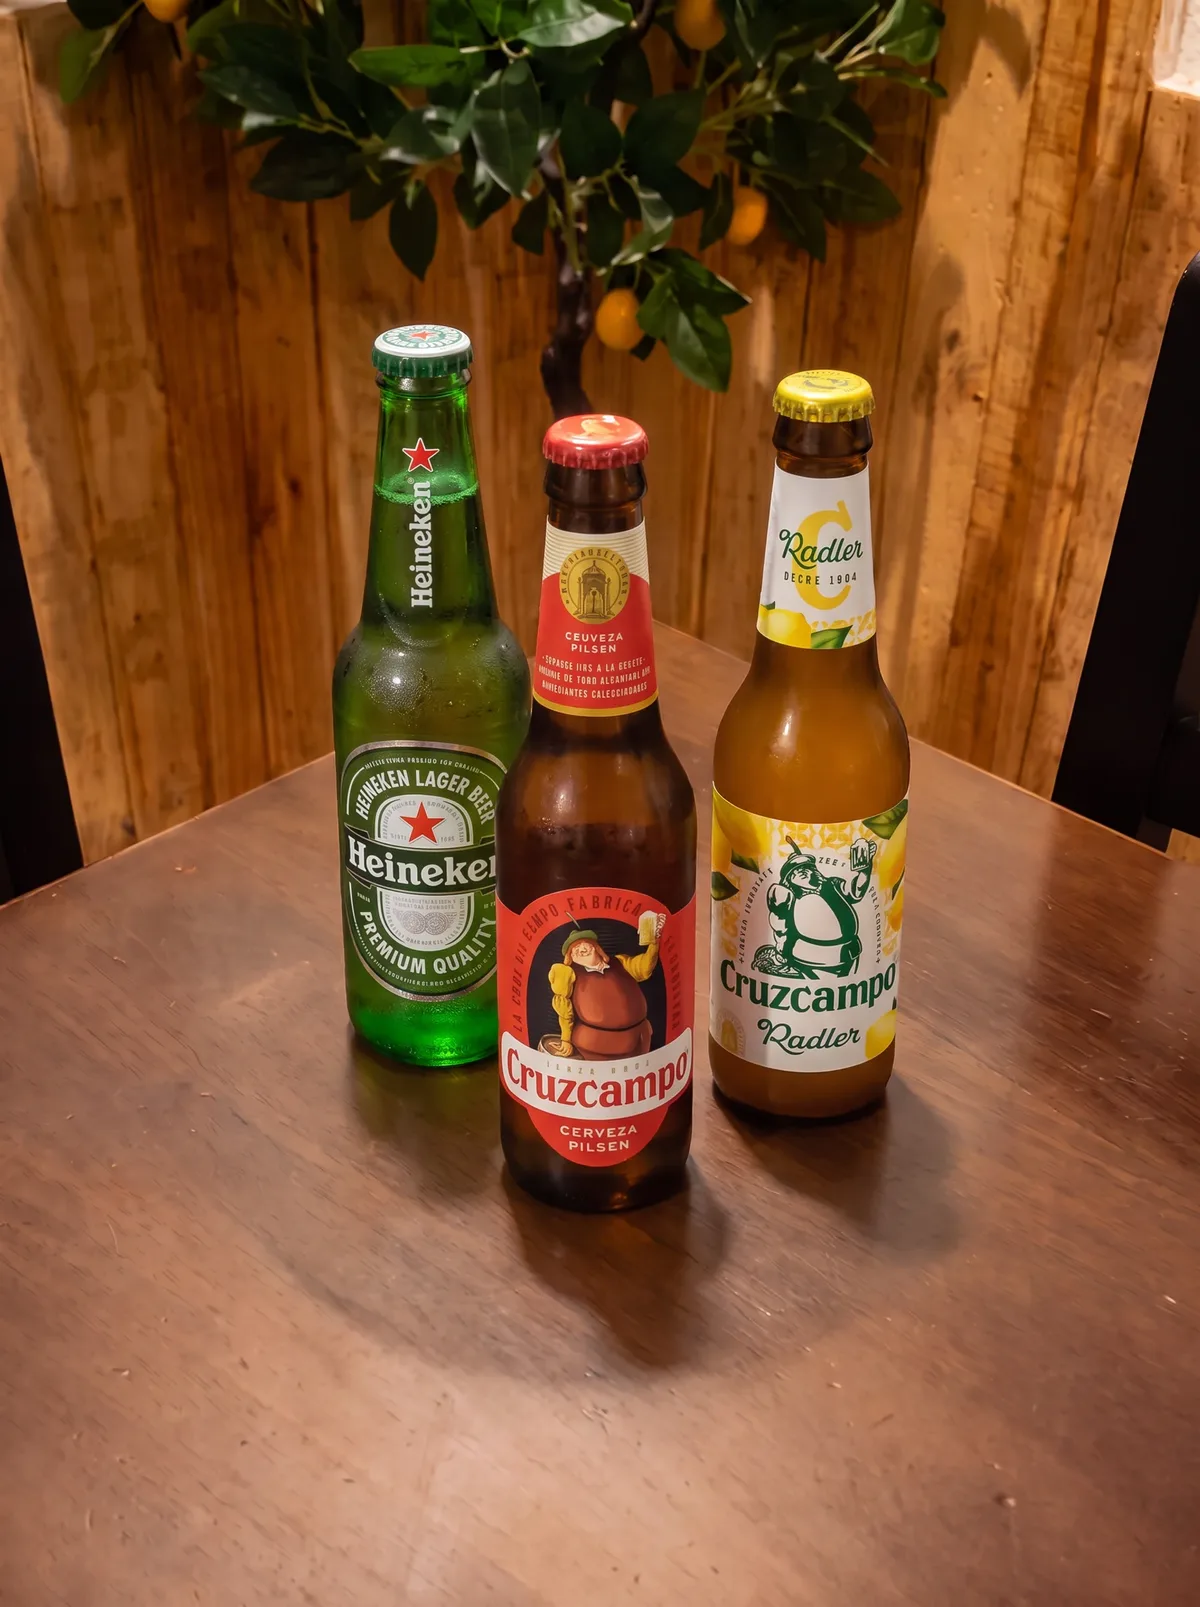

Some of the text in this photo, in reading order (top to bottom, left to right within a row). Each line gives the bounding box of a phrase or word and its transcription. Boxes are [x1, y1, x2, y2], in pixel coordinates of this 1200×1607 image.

[409, 480, 433, 608] Heineken
[779, 528, 863, 569] Radler
[784, 571, 857, 585] DECRE 1904
[565, 631, 623, 642] CEUVEZA
[571, 643, 617, 653] PILSEN
[597, 663, 602, 672] A
[605, 663, 615, 672] LA
[355, 769, 410, 821] HEINEKEN
[416, 769, 471, 796] LAGER
[467, 784, 496, 825] BEER
[566, 894, 643, 917] FABRICA
[360, 911, 426, 975] PREMIUM
[433, 916, 496, 975] QUALITY
[720, 959, 896, 1013] Cruzcampo
[757, 1018, 861, 1055] Radler
[507, 1047, 688, 1108] Cruzcampo
[560, 1125, 638, 1139] CERVEZA
[568, 1139, 630, 1152] PILSEN
